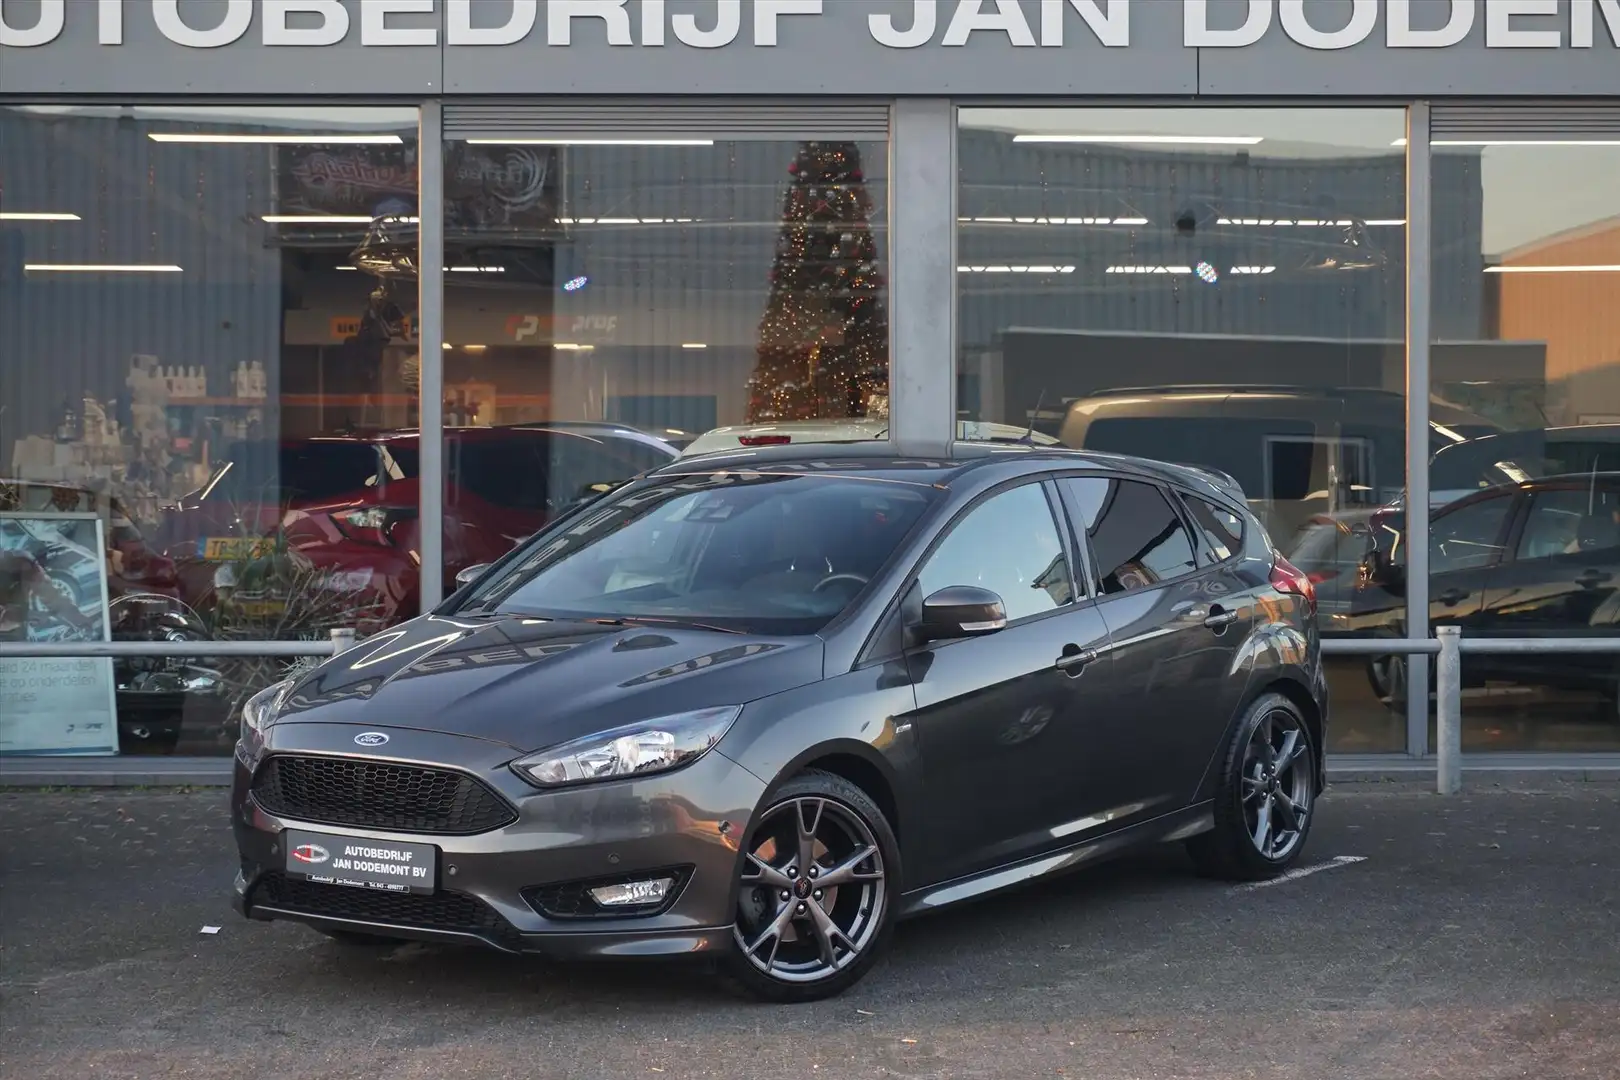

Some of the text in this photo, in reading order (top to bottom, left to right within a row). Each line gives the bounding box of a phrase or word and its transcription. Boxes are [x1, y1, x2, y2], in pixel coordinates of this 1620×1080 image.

[868, 0, 1129, 48] JAN
[345, 845, 413, 862] AUTOBEDRIJF
[332, 858, 427, 878] JAN DODEMONT BV
